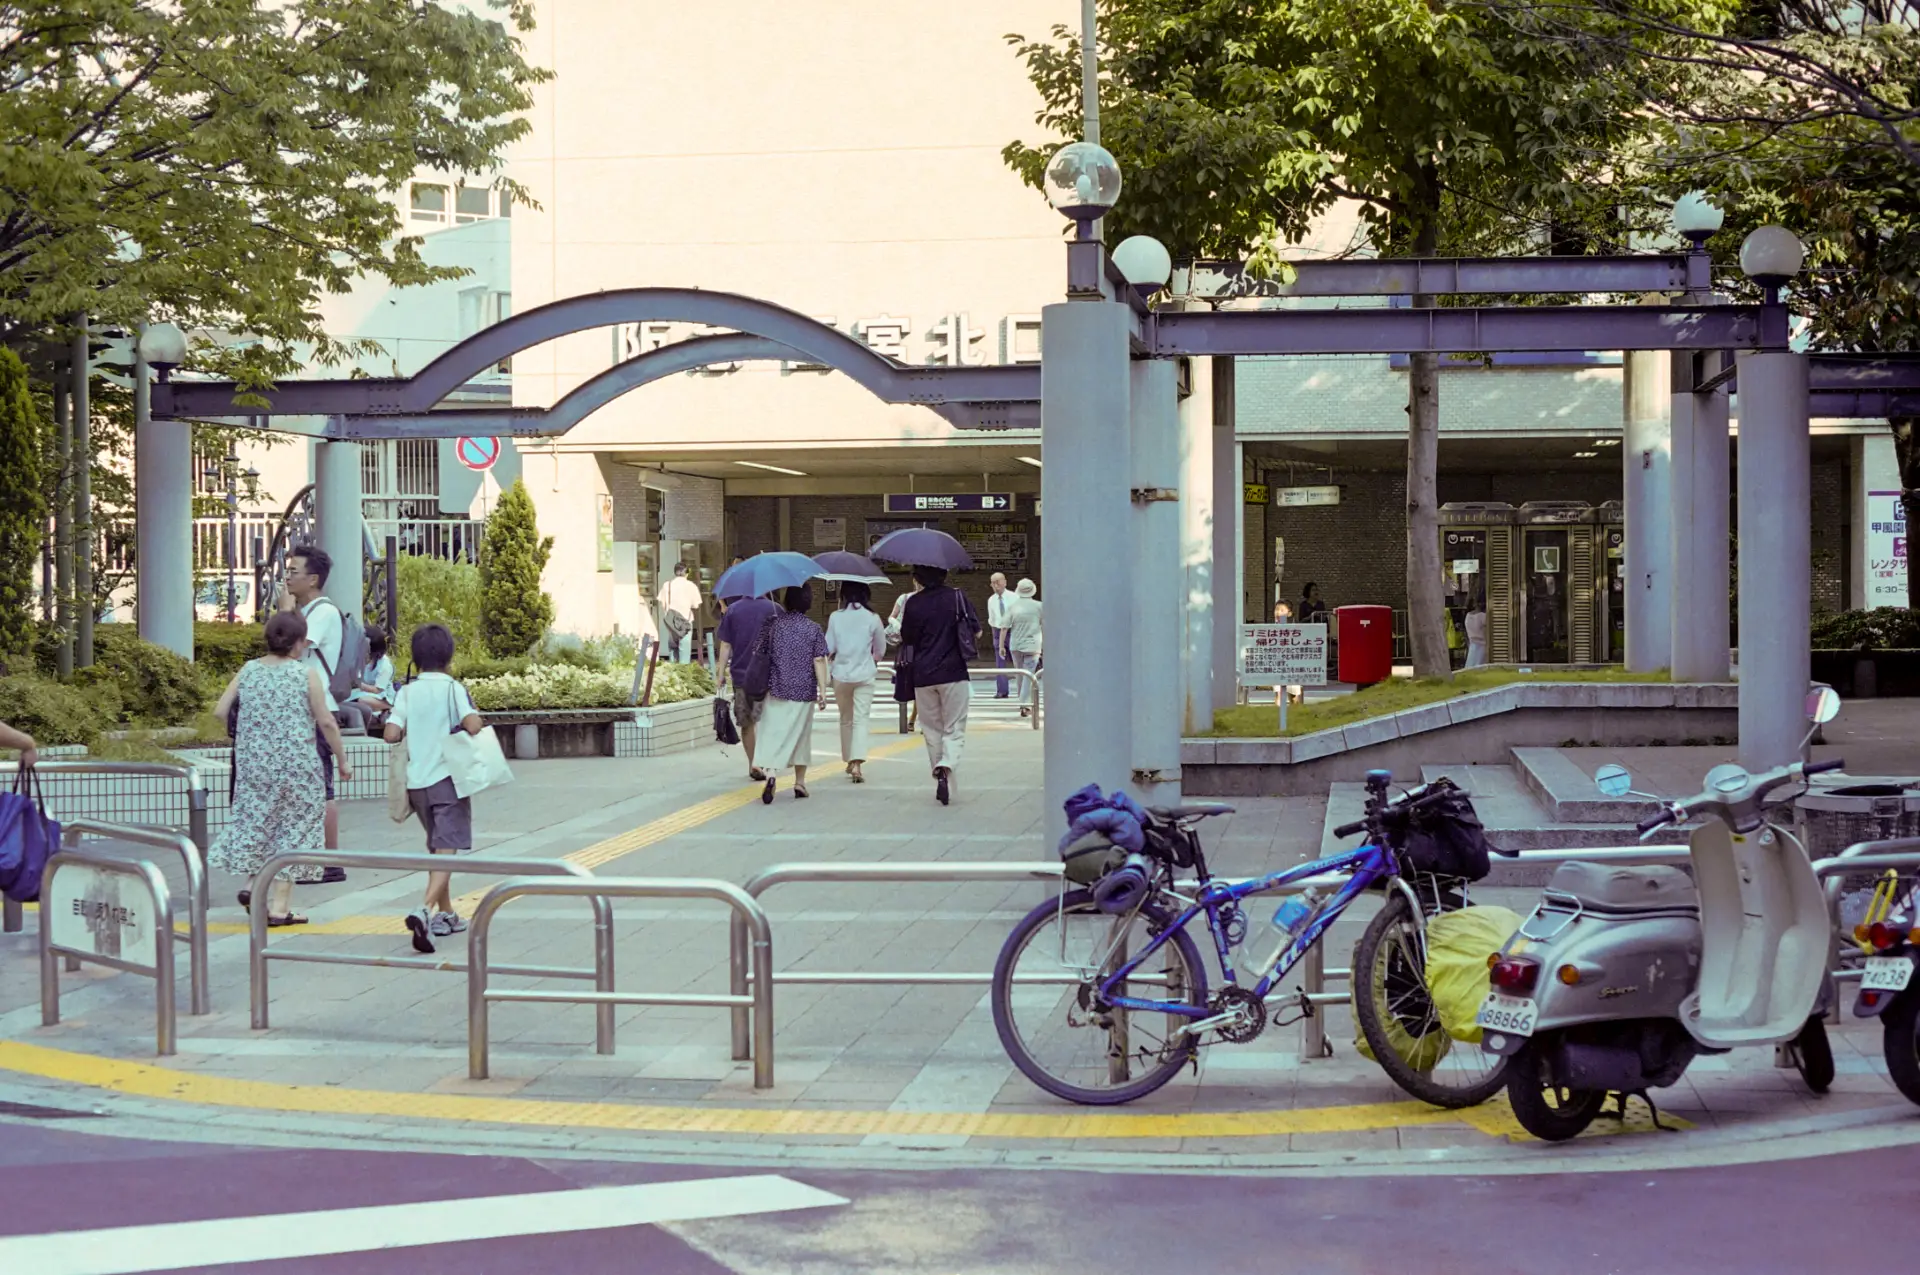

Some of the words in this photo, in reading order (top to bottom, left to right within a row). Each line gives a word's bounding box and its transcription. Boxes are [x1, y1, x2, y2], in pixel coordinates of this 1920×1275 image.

[1871, 522, 1906, 533] 甲風園
[1244, 629, 1302, 637] ゴミは持ち
[1256, 637, 1325, 647] 帰りましょう
[1483, 1009, 1533, 1032] 88866
